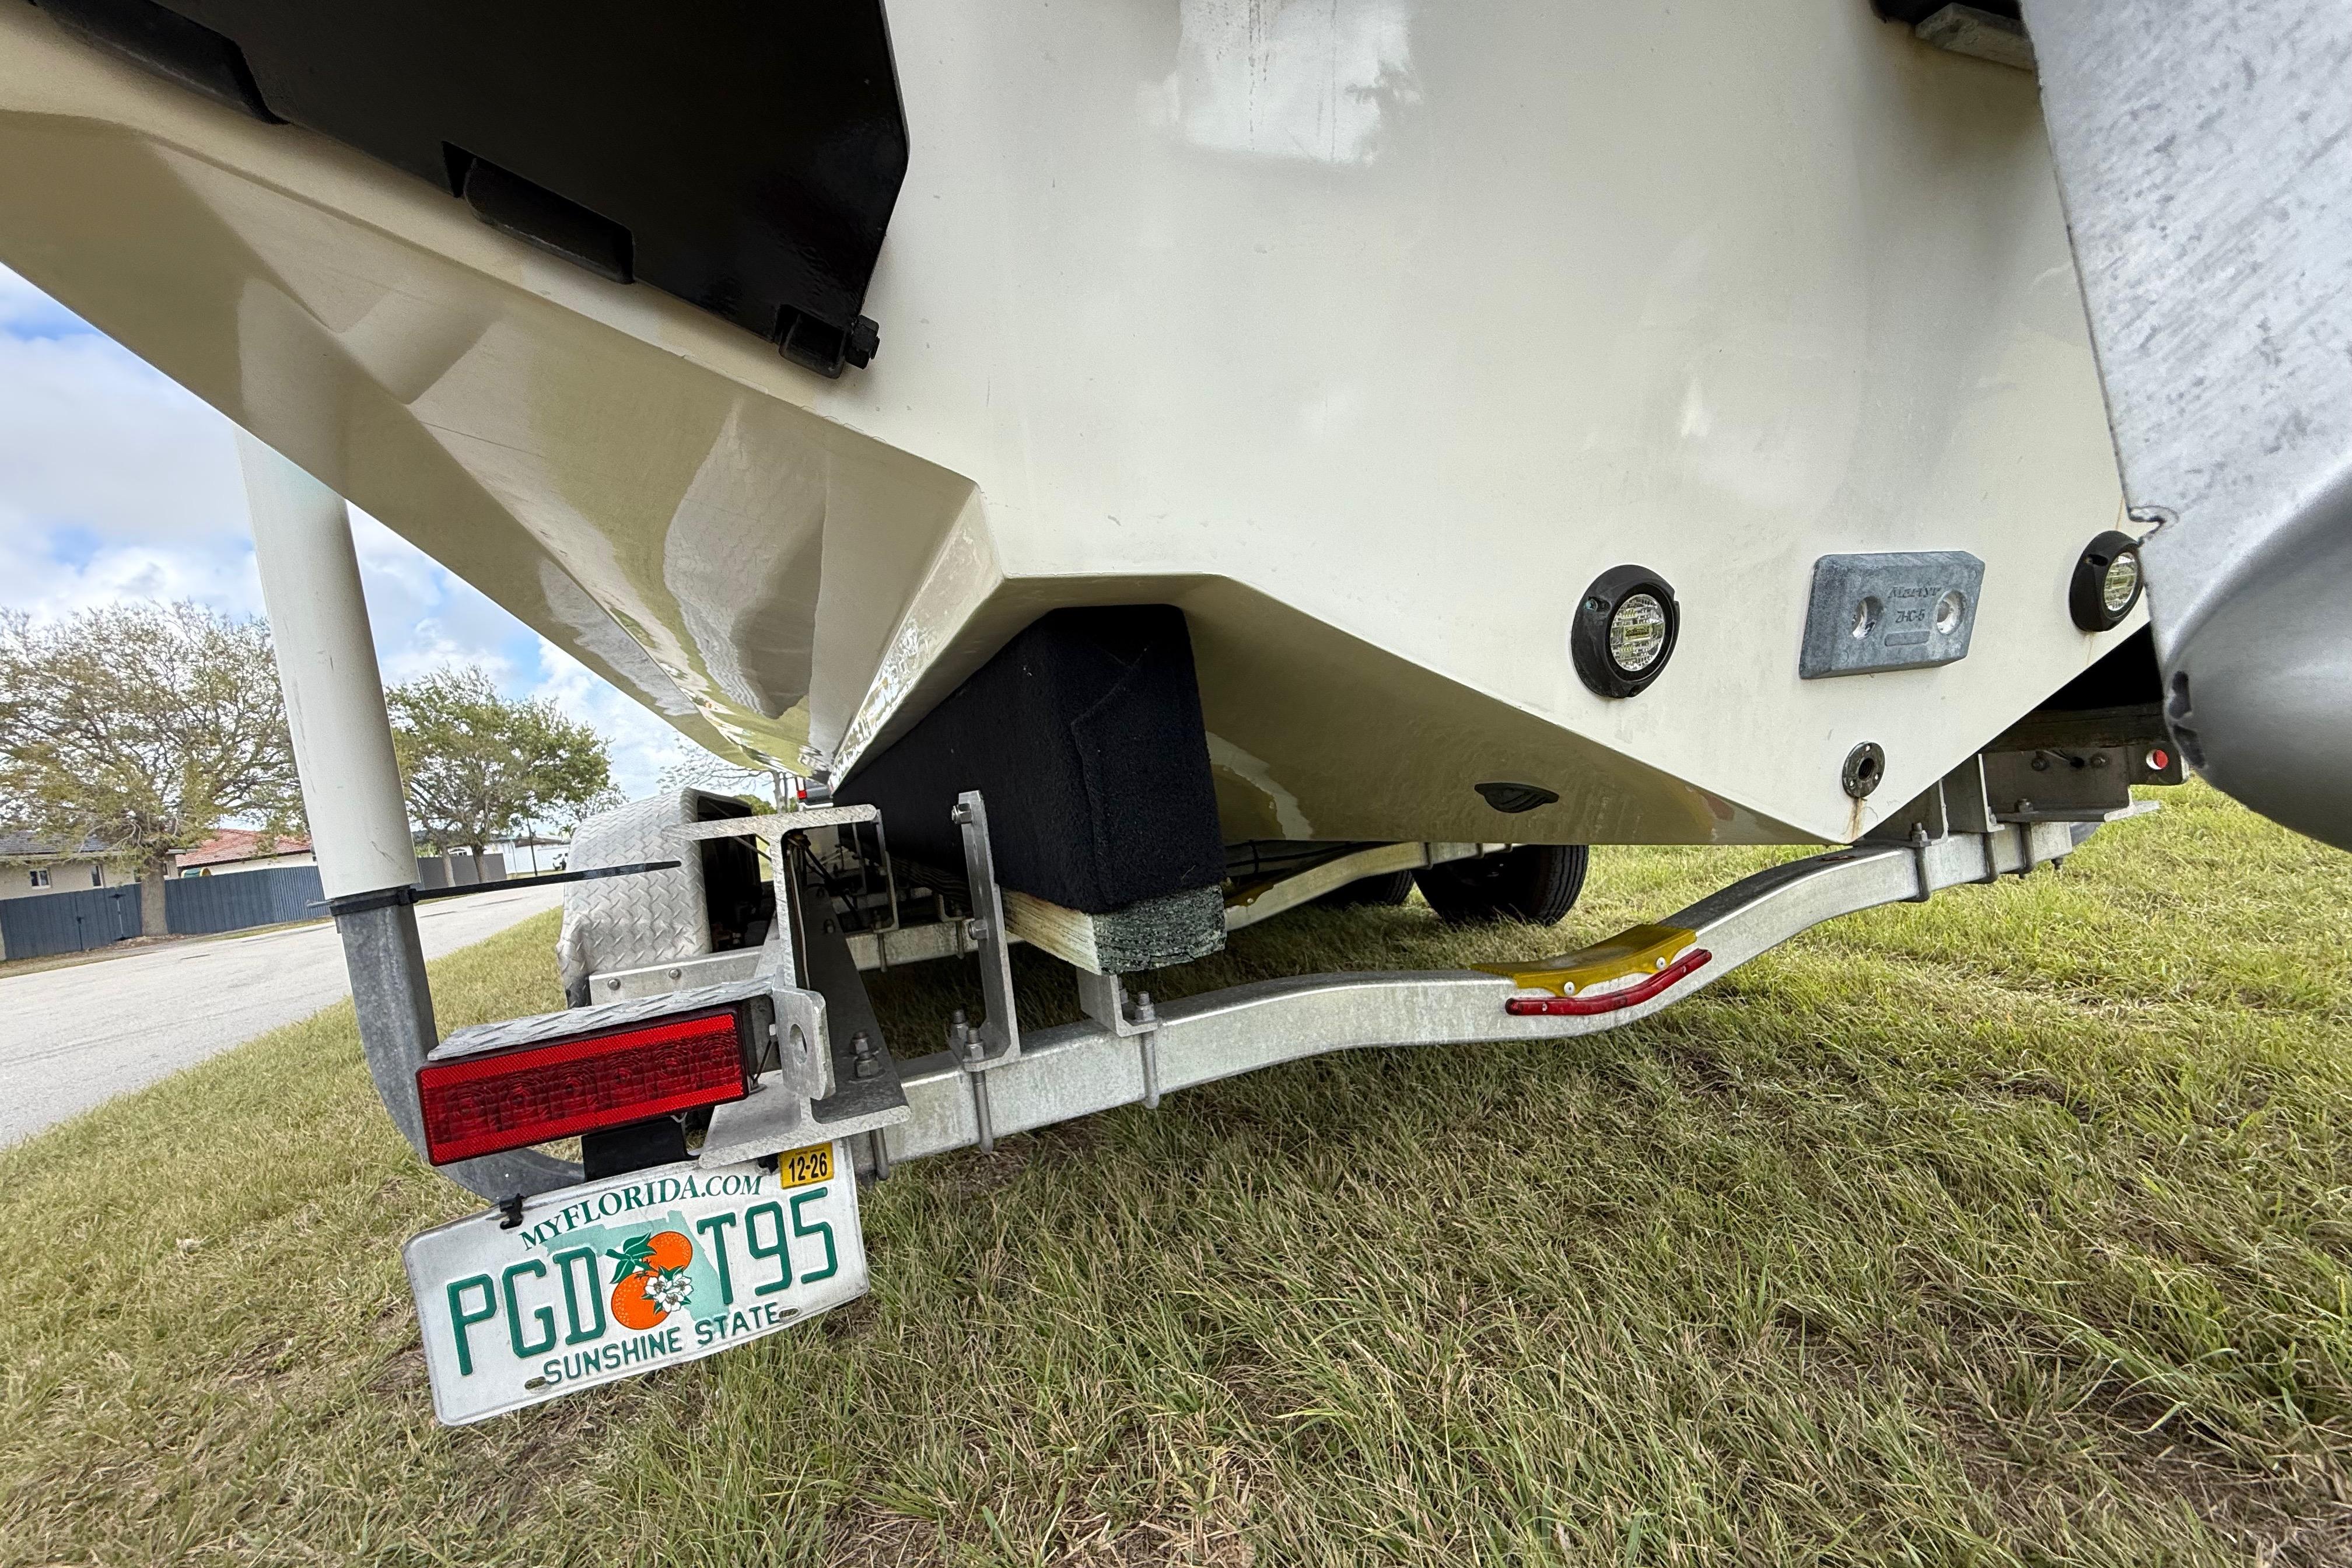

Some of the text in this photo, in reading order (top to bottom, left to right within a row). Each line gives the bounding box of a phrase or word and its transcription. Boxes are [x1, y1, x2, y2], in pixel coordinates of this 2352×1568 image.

[1895, 608, 1926, 624] ZHC-5
[789, 1152, 828, 1183] 12-26
[518, 1174, 762, 1251] MYFLORIDA.COM
[447, 1186, 839, 1376] PGD T95
[543, 1301, 782, 1385] SUNSHINE STATE
